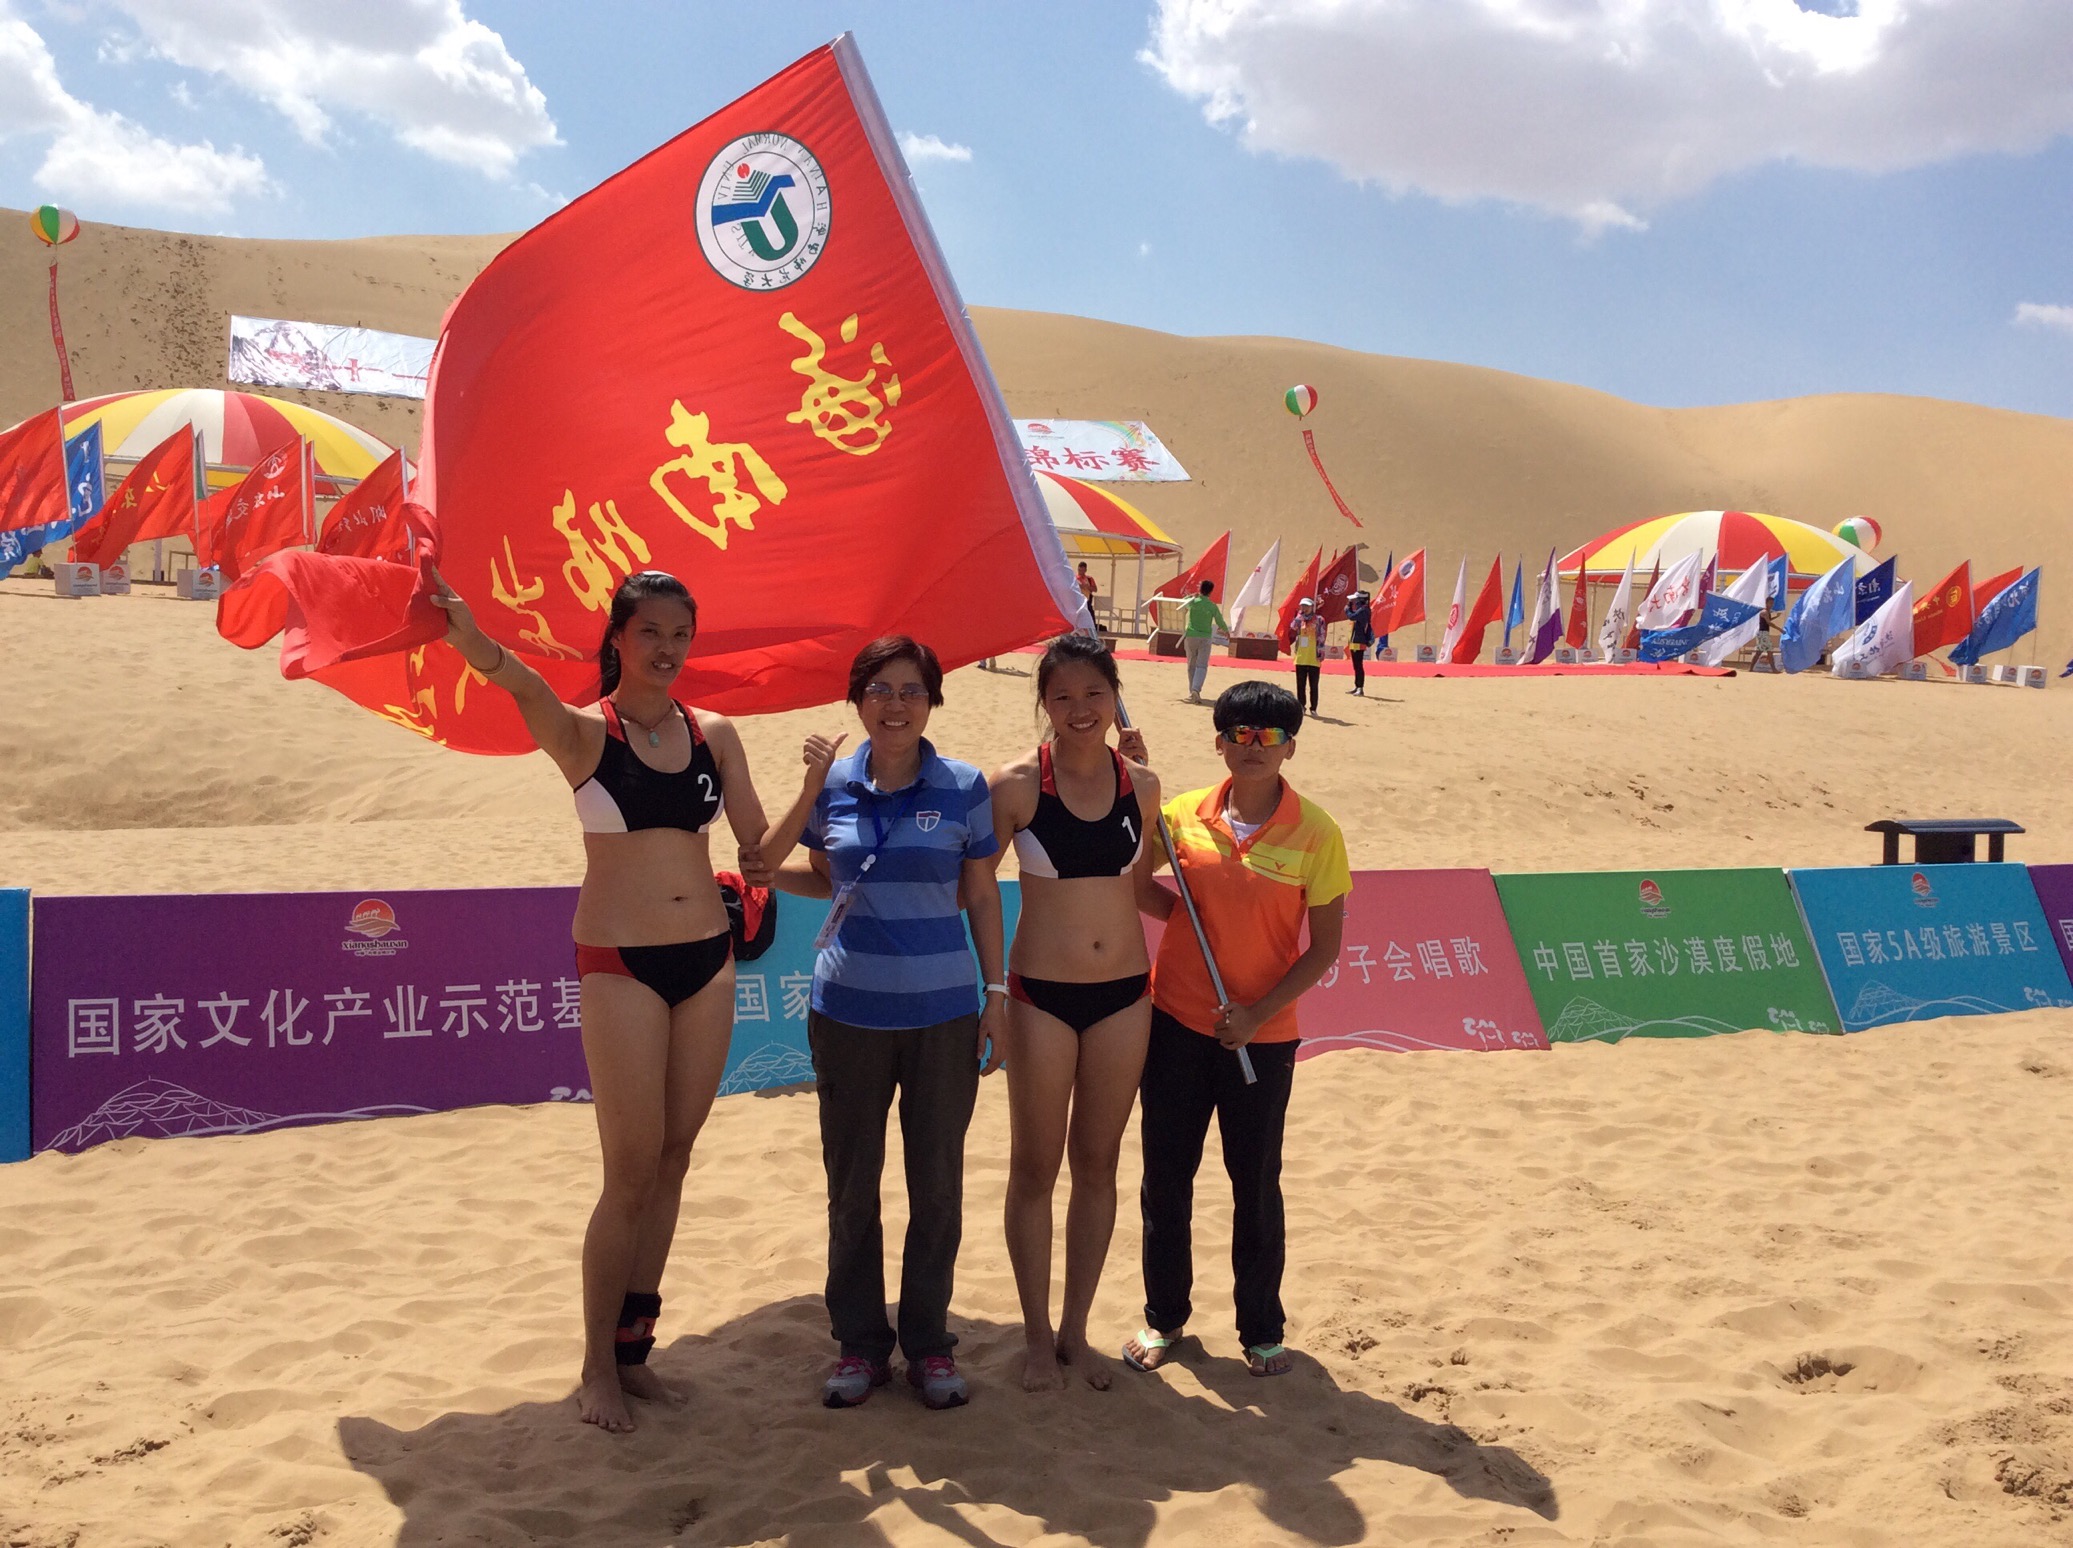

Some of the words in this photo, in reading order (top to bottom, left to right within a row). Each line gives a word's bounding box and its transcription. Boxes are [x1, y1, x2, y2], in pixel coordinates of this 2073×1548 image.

[697, 773, 718, 802] 2
[1121, 815, 1137, 843] 1
[1533, 932, 1800, 982] 中国首家沙漠度假地
[1836, 920, 2039, 967] 国家5A级旅游景区
[734, 970, 813, 1025] 国家
